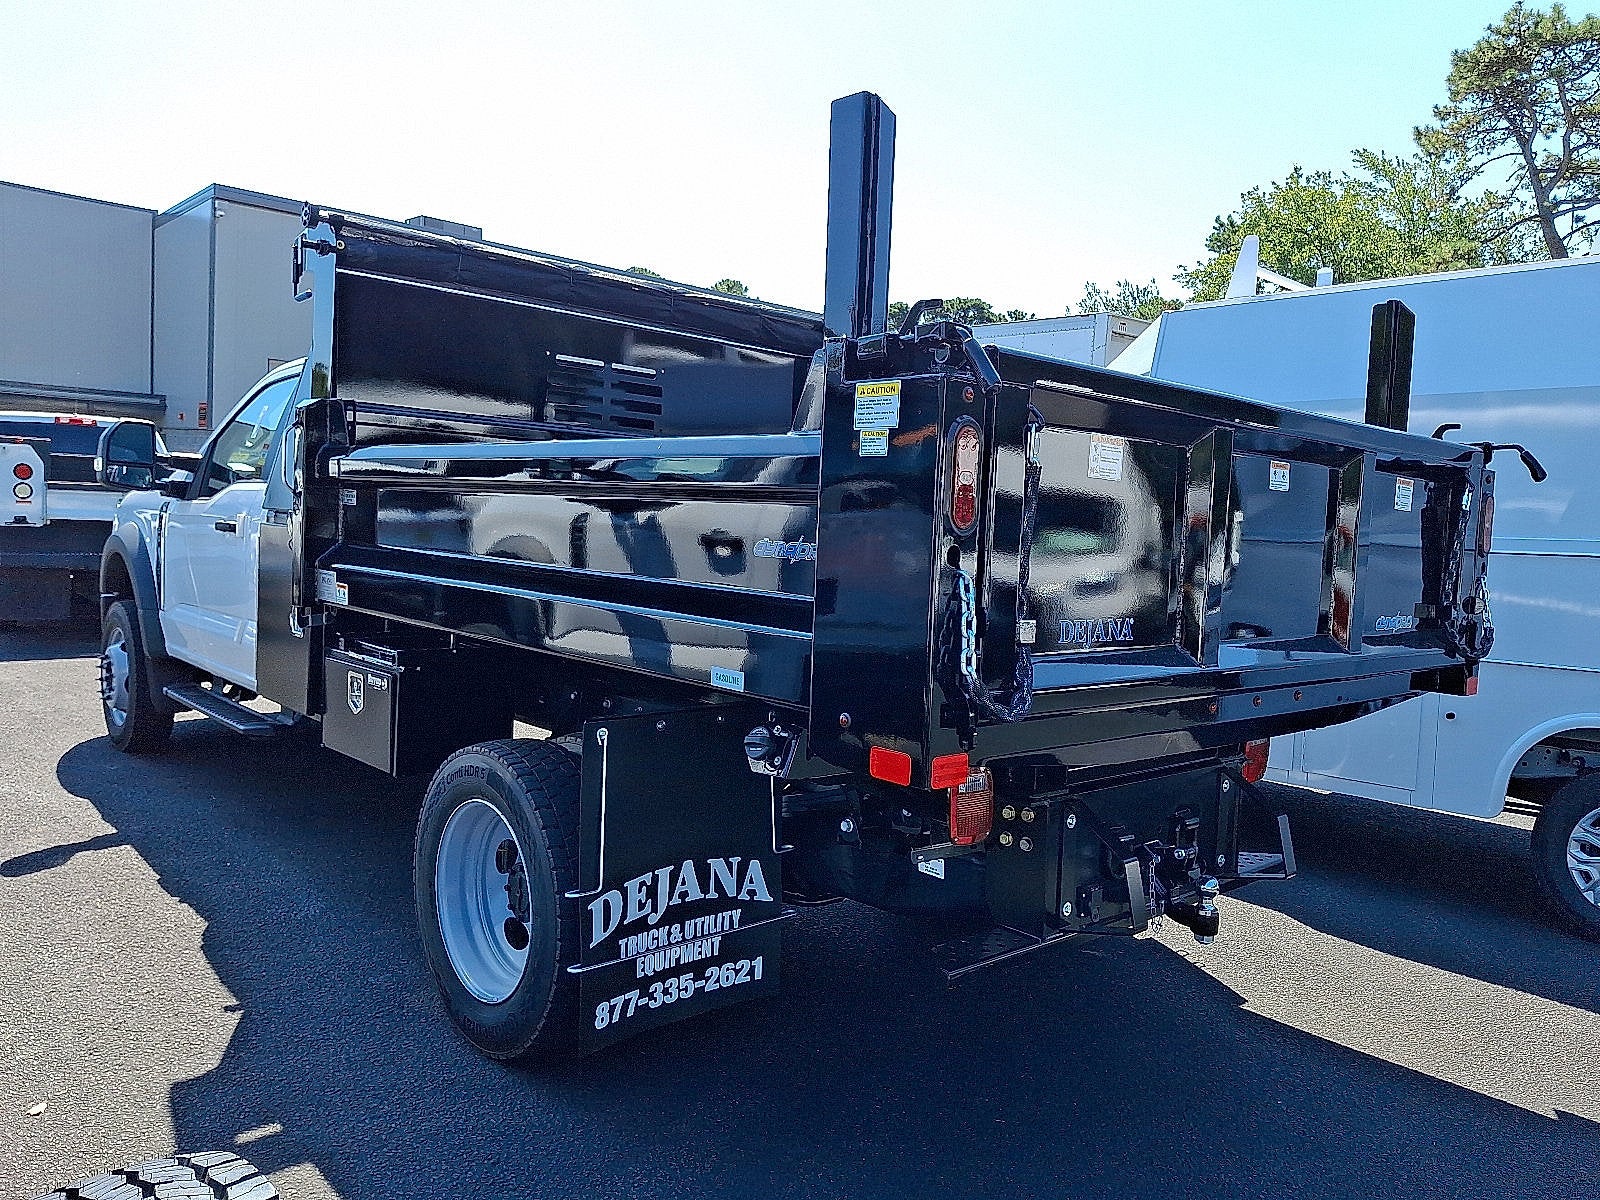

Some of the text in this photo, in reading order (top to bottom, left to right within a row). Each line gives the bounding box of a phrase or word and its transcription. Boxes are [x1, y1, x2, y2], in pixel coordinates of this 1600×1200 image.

[866, 385, 896, 395] CAUTION
[587, 856, 774, 949] DEJANA
[618, 908, 742, 959] TRUCK & UTILITY
[636, 936, 722, 978] EQUIPMENT
[594, 956, 764, 1030] 877-335-2621
